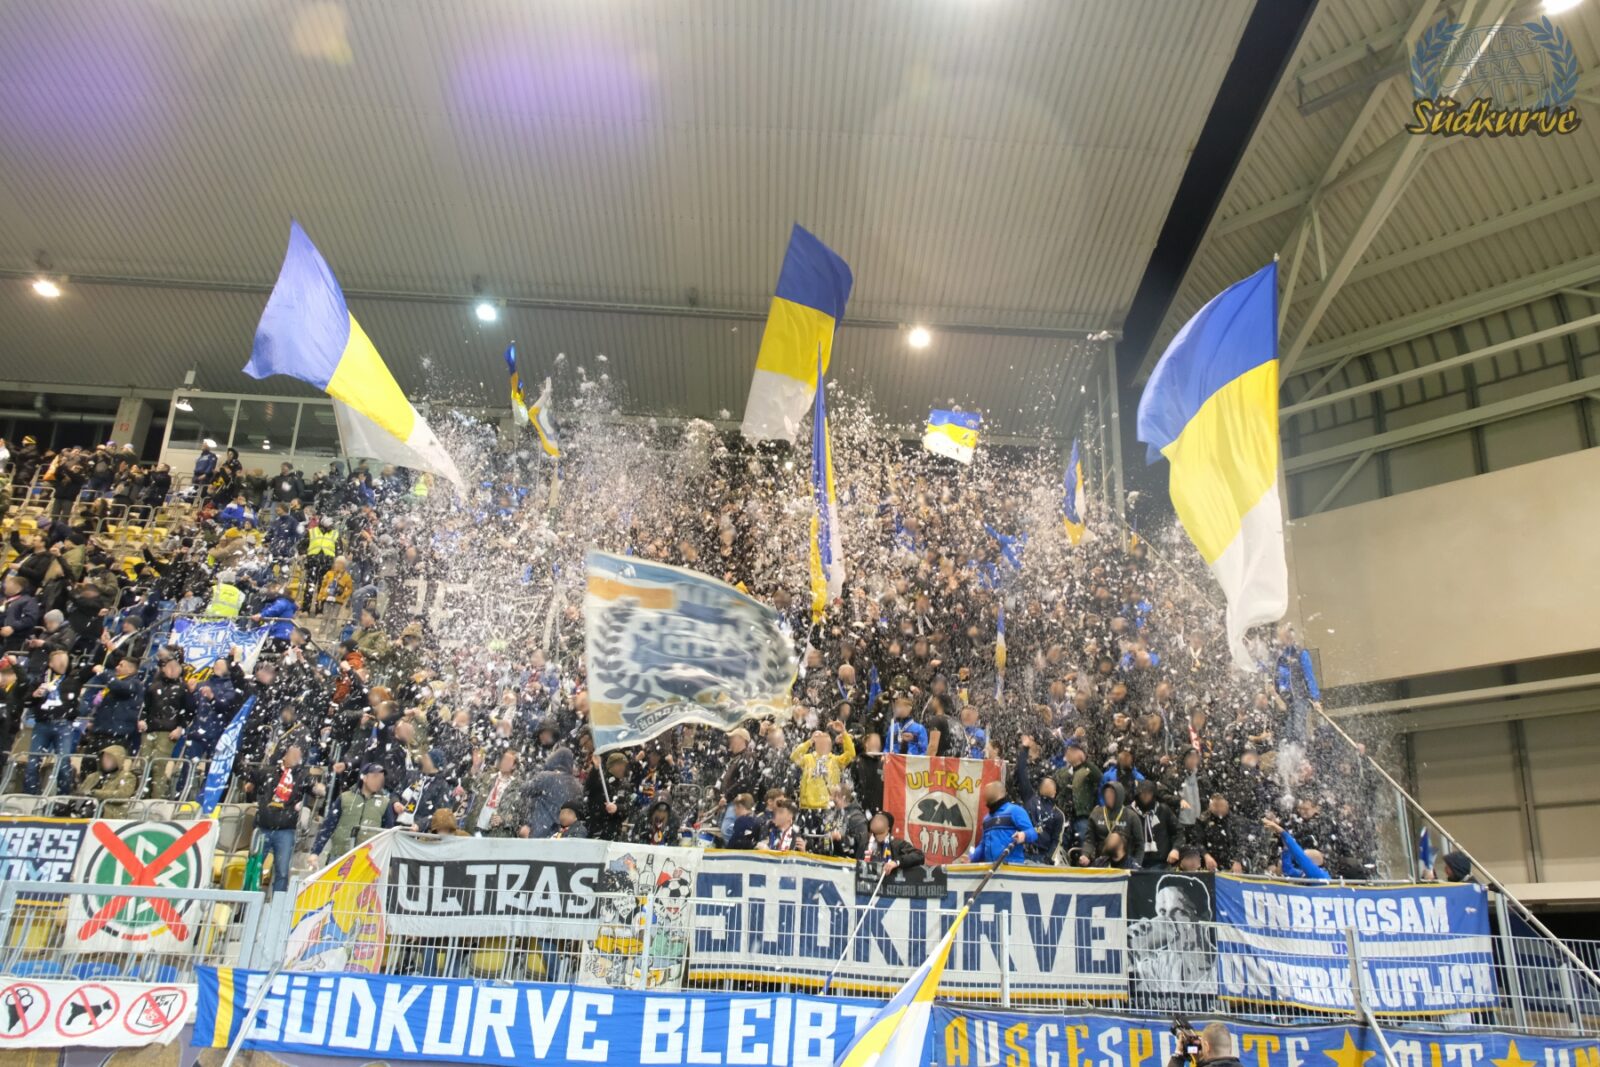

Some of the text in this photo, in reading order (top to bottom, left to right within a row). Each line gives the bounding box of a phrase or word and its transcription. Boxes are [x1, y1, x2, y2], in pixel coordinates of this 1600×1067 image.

[397, 863, 600, 915] ULTRAS
[1241, 889, 1450, 936] UNBEUGSAM
[244, 974, 613, 1062] SÜDKURVE
